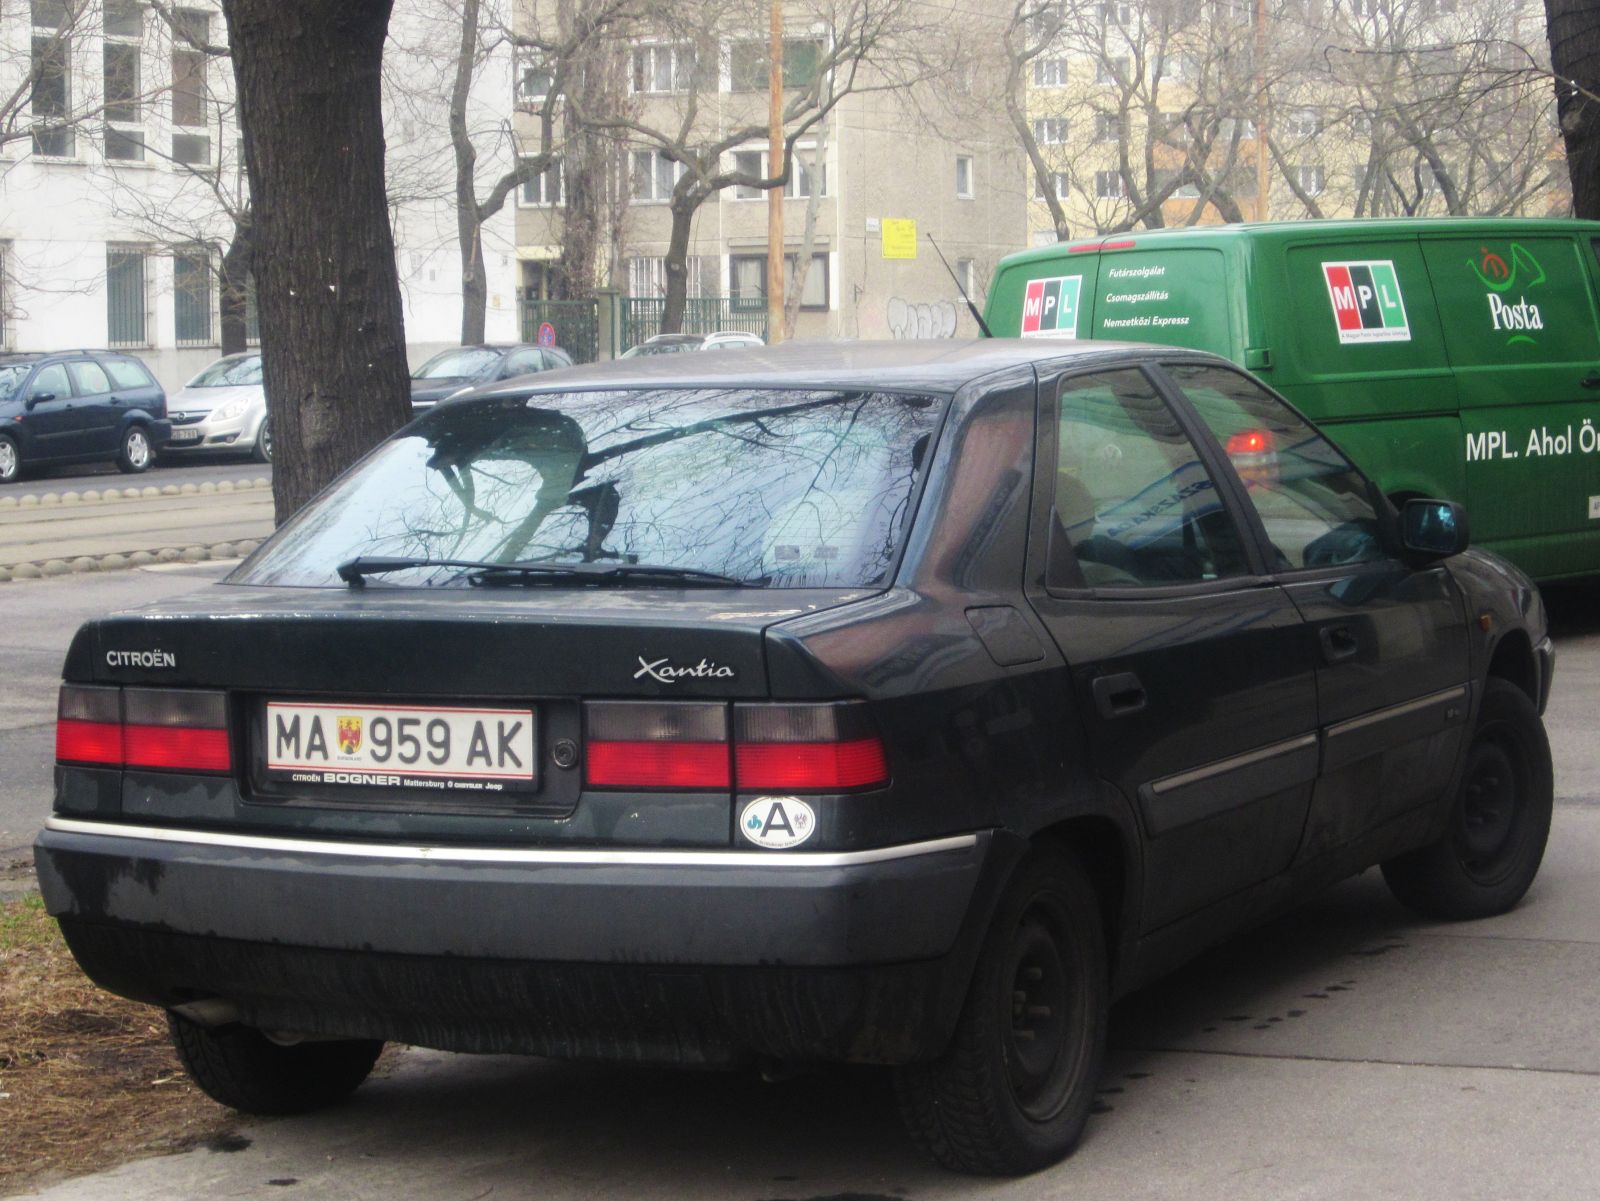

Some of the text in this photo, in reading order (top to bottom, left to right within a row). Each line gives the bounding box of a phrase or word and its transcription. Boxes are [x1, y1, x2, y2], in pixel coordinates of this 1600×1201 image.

[1108, 266, 1166, 278] Futárszolgálat
[1025, 295, 1073, 317] MPL
[1106, 291, 1169, 304] Csomagszállítás
[1332, 284, 1396, 310] MPL
[1103, 315, 1190, 328] Nemzetközi Expressz
[1487, 293, 1544, 330] Posta
[1466, 431, 1519, 461] MPL.
[1525, 425, 1572, 457] Ahol
[106, 649, 176, 667] CITROËN
[633, 655, 735, 683] Xantia
[276, 713, 523, 769] MA 959 AK
[291, 773, 321, 783] CITROËN
[323, 772, 401, 786] BOGNER
[403, 779, 445, 789] Mattersburg
[485, 782, 503, 791] Jeep
[760, 802, 796, 838] A
